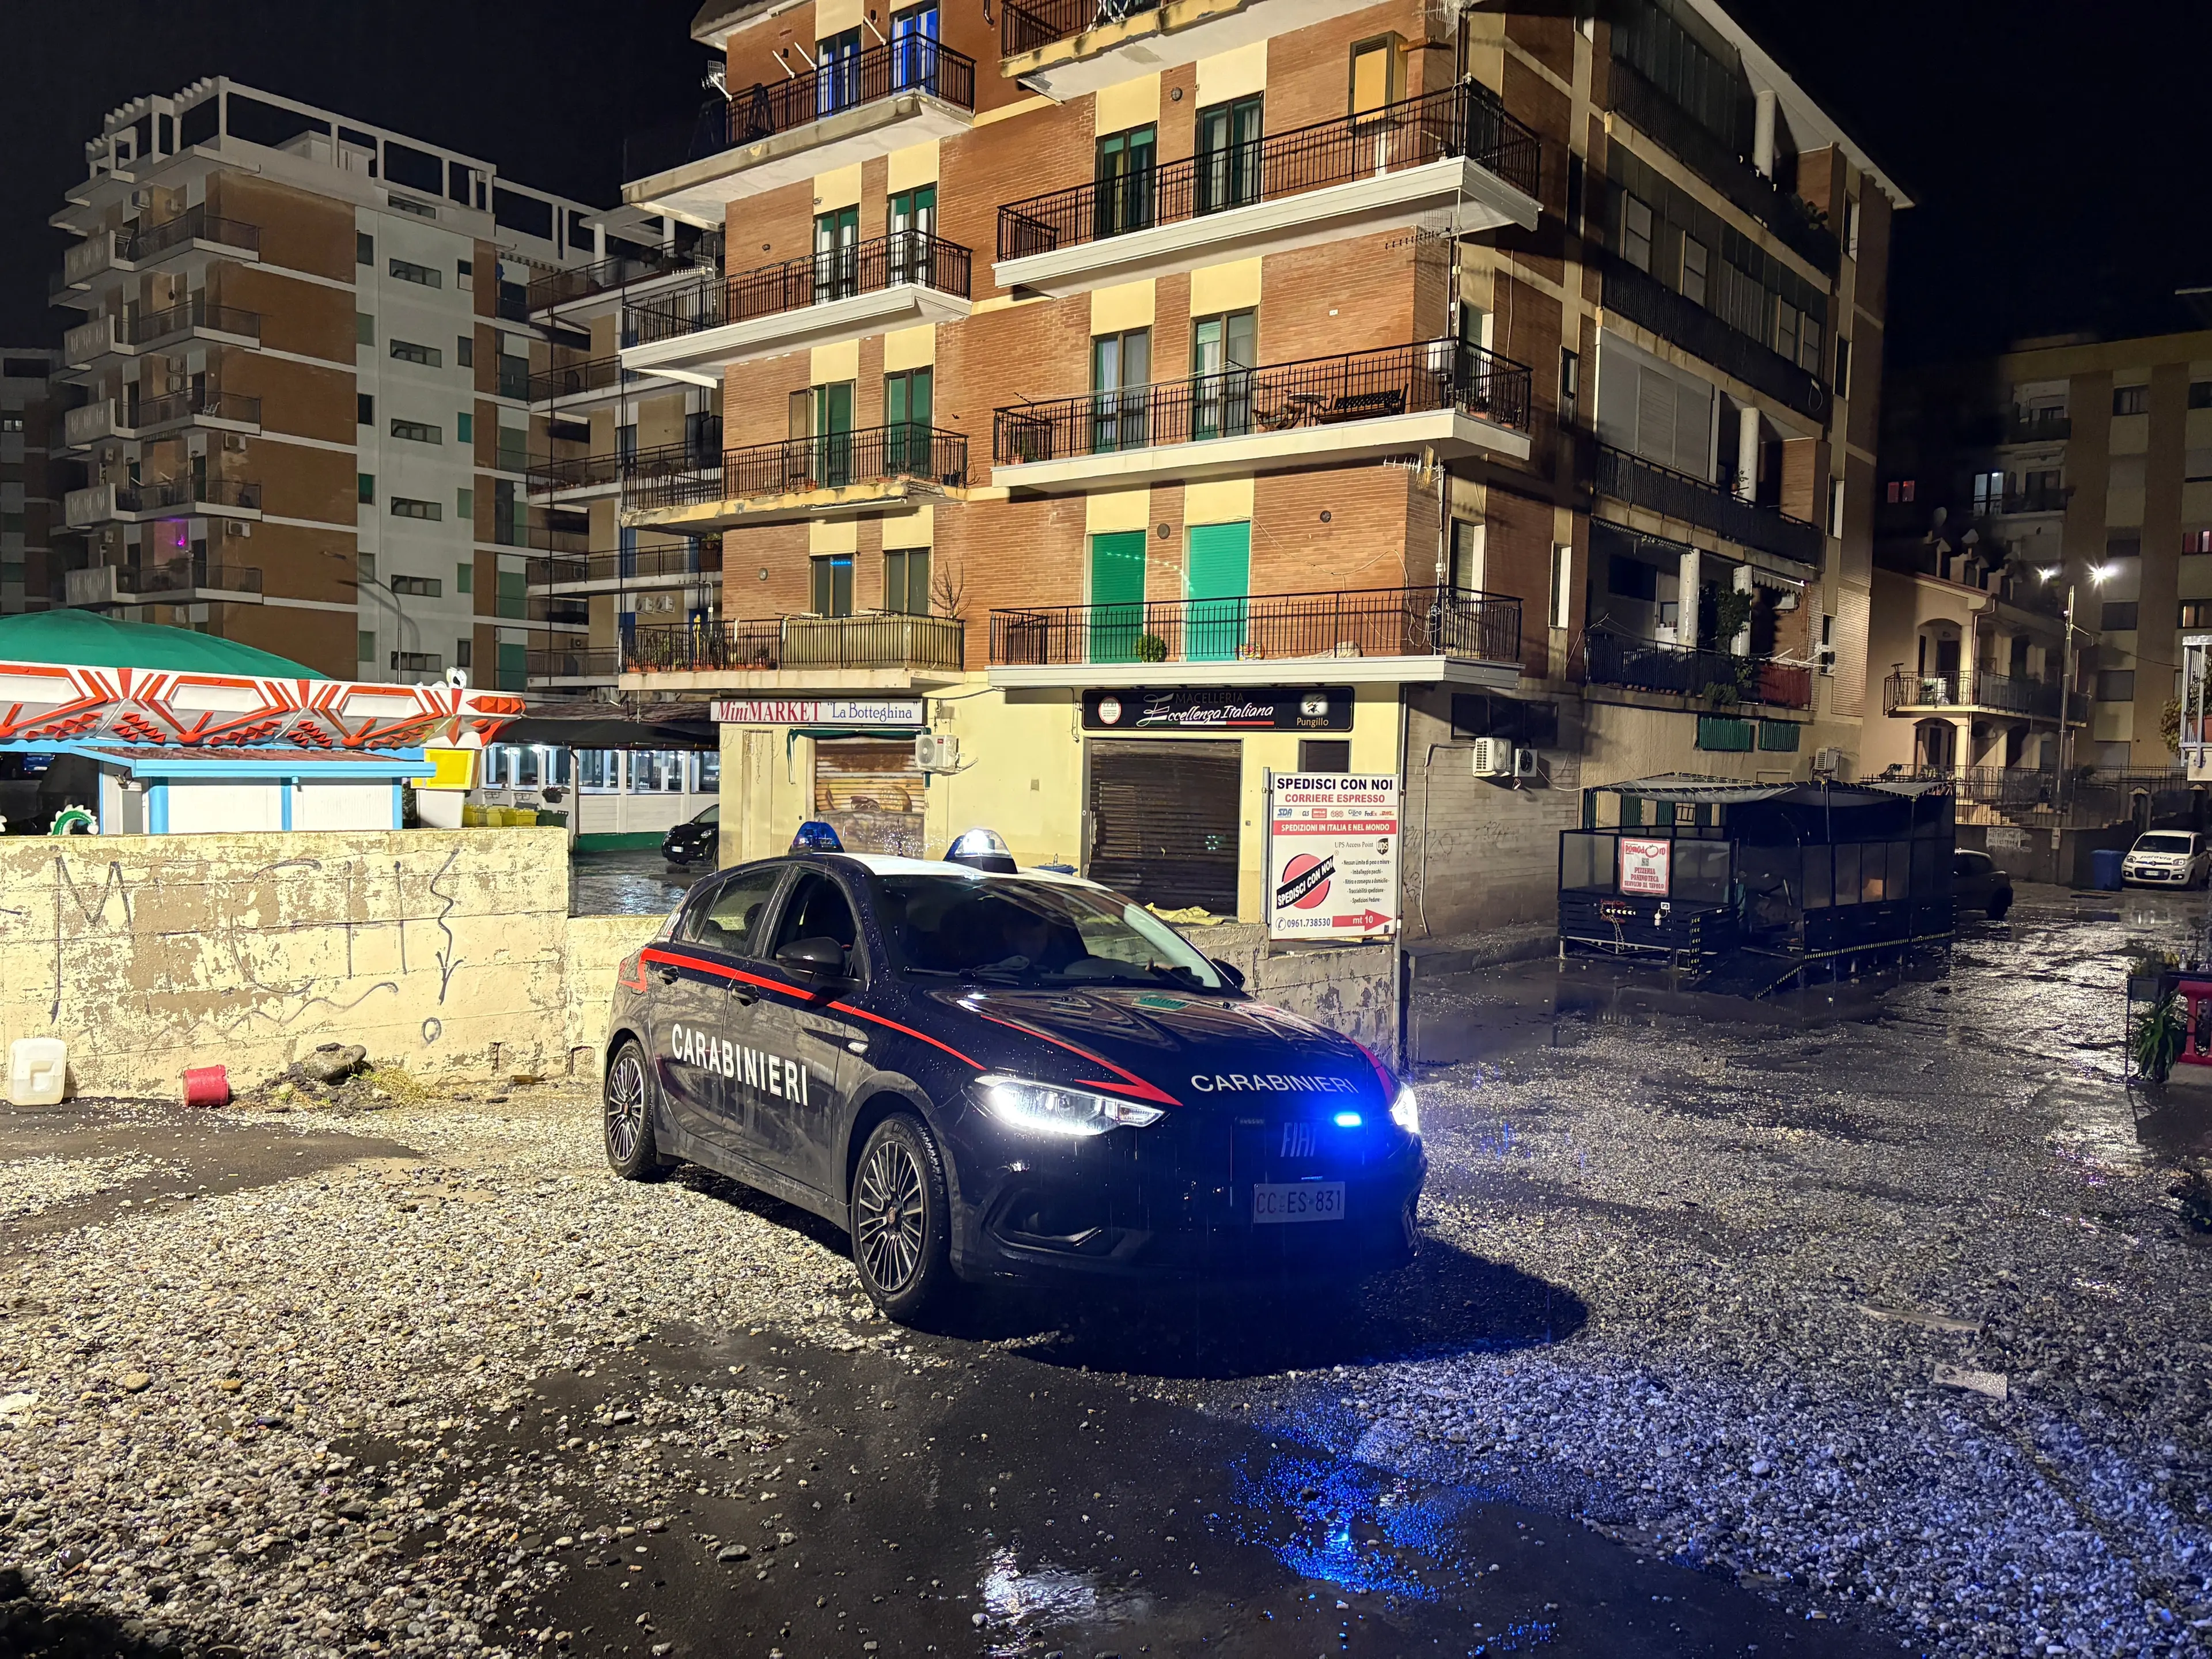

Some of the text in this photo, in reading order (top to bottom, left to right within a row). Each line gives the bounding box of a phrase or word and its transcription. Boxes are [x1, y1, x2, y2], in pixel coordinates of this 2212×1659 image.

[1175, 692, 1244, 703] MACELLERIA
[717, 701, 821, 722] MiniMARKET
[1219, 702, 1274, 719] Italiana
[1297, 717, 1329, 728] Pungillo
[1277, 778, 1392, 790] SPEDISCI CON NOI
[1285, 794, 1385, 802] CORRIERE ESPRESSO
[1277, 808, 1292, 816] SDA
[1281, 824, 1317, 832] SPEDIZIONI
[1377, 842, 1388, 853] ups
[1278, 859, 1332, 906] SPEDISCI CON NOI
[1631, 874, 1659, 882] PANINOTECA
[1287, 919, 1331, 927] 0961.738530
[671, 1023, 808, 1107] CARABINIERI
[1191, 1074, 1359, 1094] CARABINIERI
[1280, 1122, 1318, 1157] FIAT
[1256, 1190, 1340, 1214] CC ES 831
